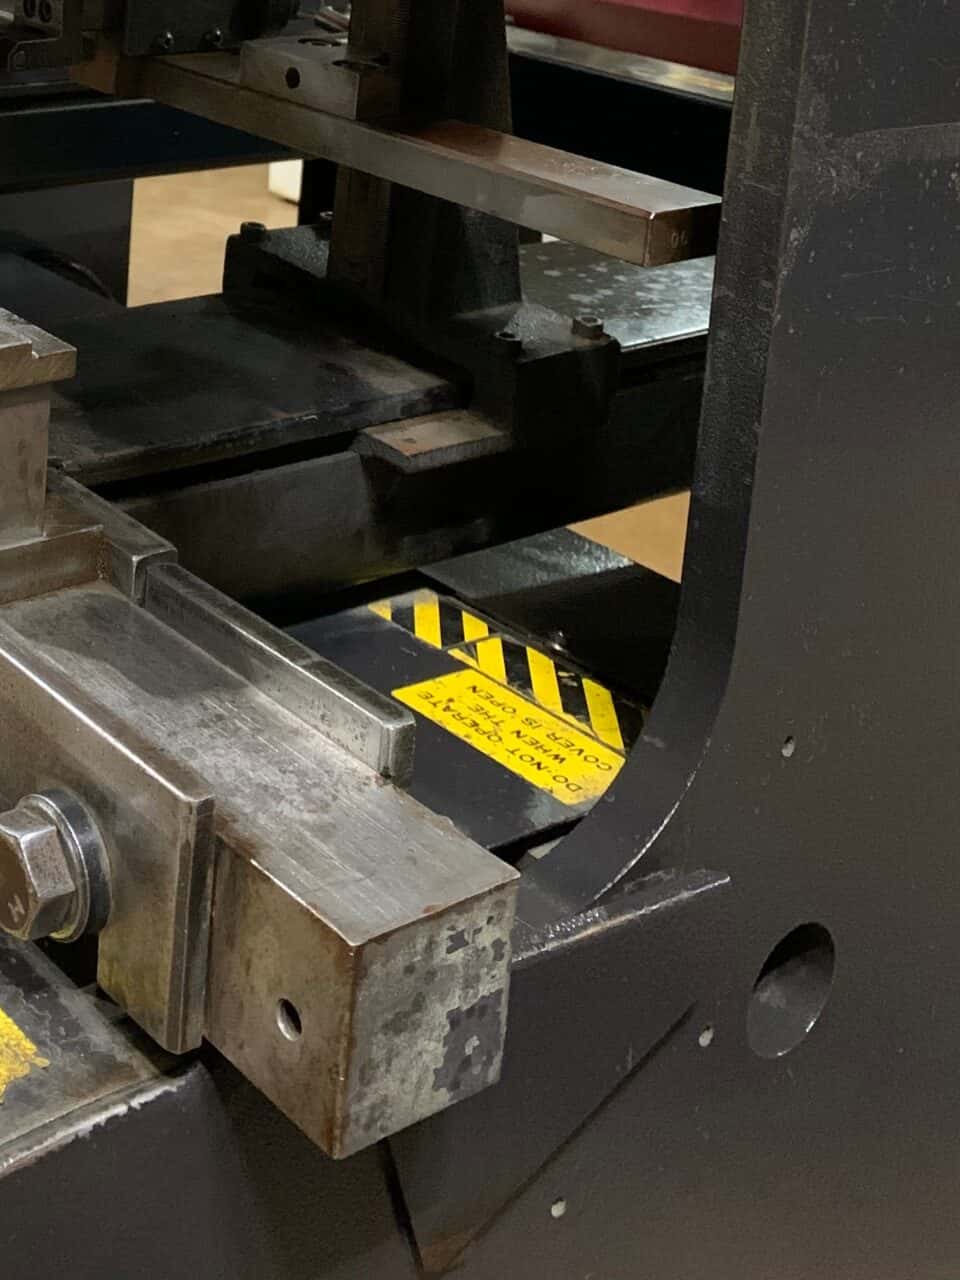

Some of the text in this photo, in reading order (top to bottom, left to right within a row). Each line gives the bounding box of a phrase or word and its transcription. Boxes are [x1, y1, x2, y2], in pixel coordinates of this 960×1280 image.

[418, 692, 584, 793] DO NOT OPERATE
[467, 684, 613, 772] COVER IS OPEN
[467, 703, 567, 764] WHEN THE
